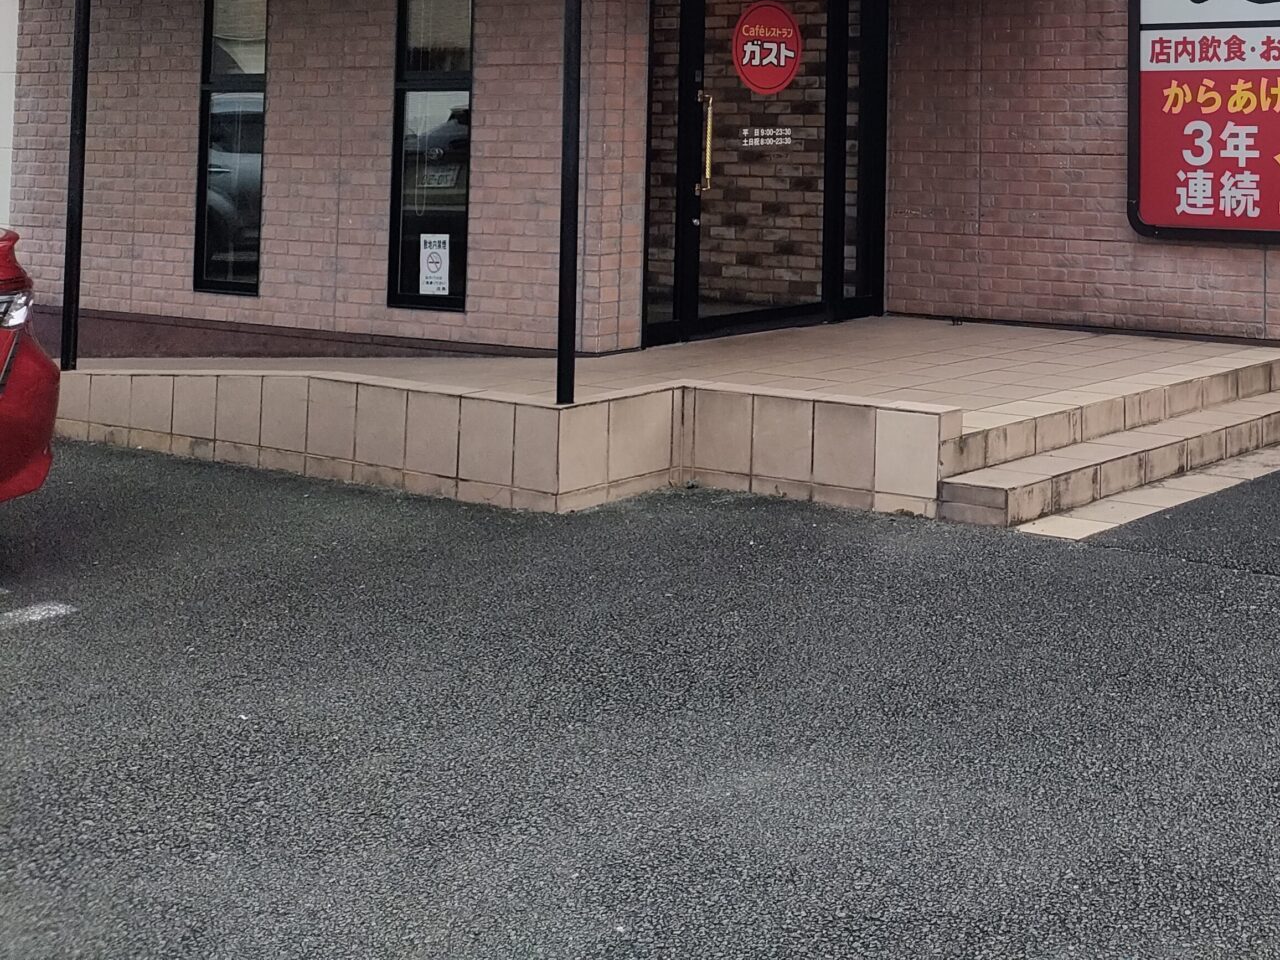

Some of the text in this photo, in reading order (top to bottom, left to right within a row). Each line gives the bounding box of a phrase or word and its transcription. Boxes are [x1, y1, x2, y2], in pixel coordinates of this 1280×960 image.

[742, 40, 795, 67] ガスト
[1181, 119, 1261, 168] 3年
[1175, 169, 1261, 218] 連続
